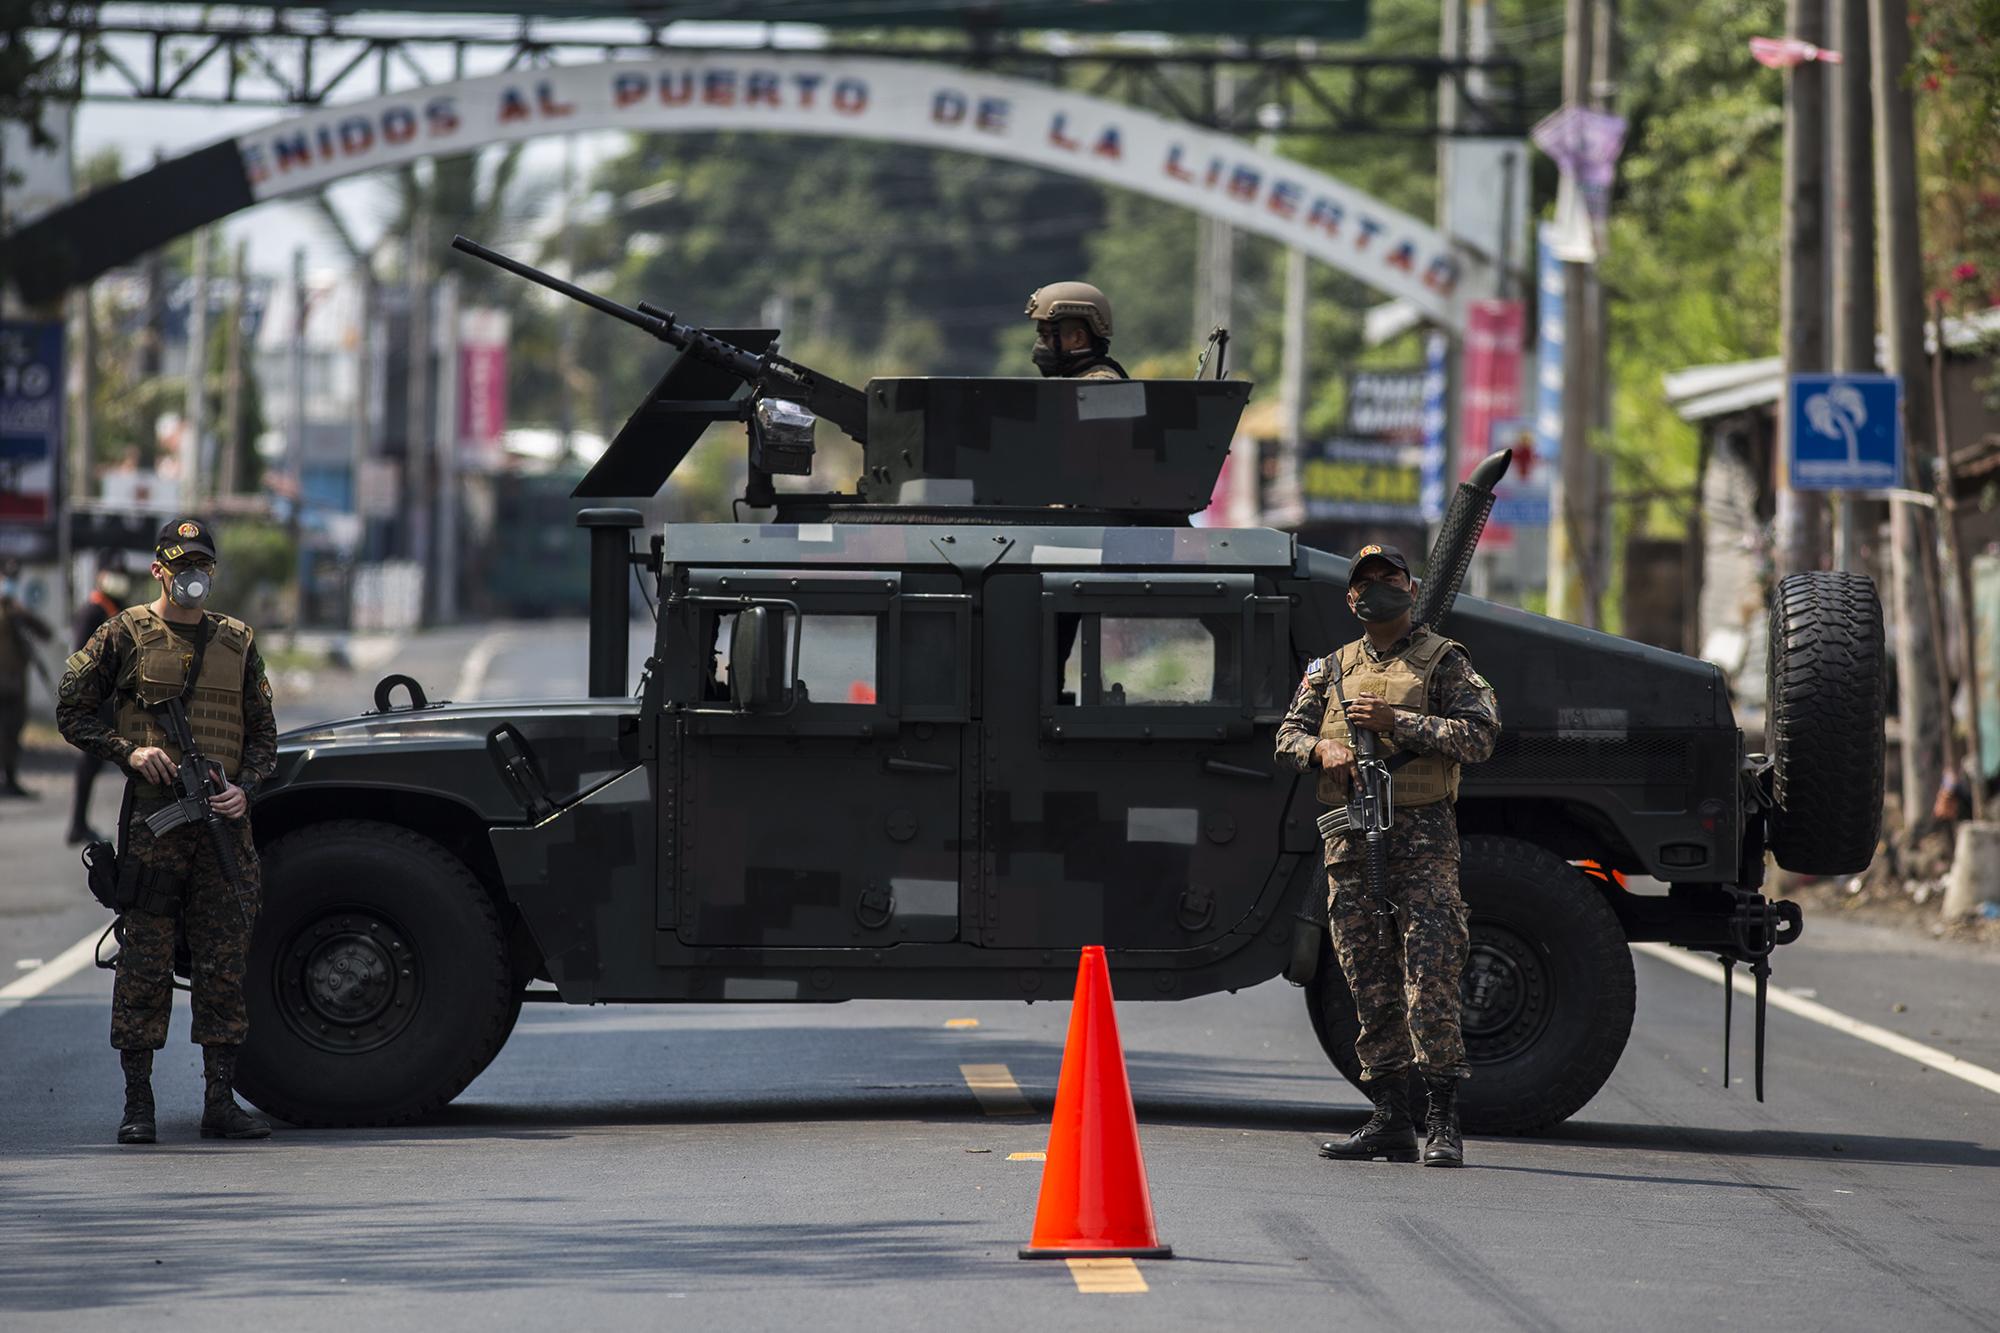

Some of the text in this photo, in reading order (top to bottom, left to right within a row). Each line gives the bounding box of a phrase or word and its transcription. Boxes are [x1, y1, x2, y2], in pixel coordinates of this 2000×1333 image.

[497, 80, 577, 125] AL
[613, 69, 869, 118] PUERTO
[930, 87, 1011, 137] DE
[1048, 111, 1121, 164] LA
[1163, 143, 1461, 298] LIBERTAD
